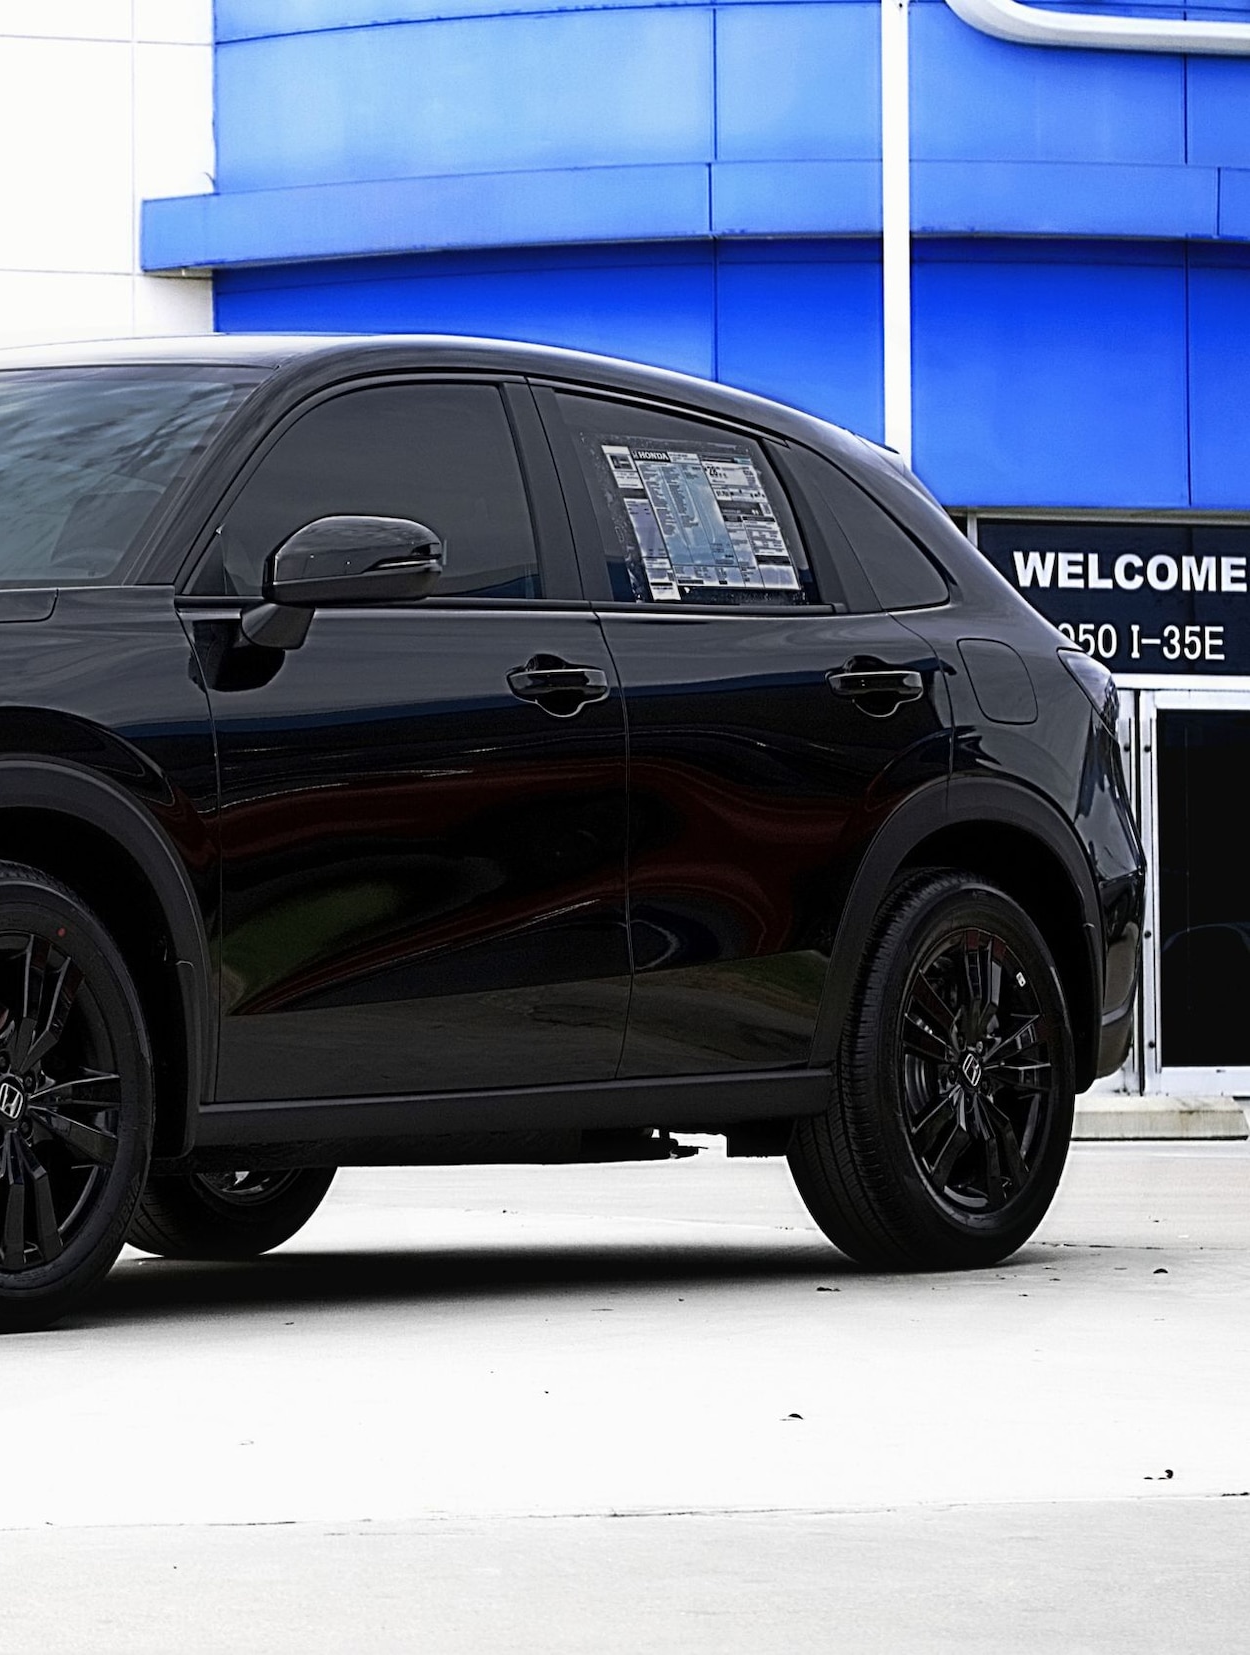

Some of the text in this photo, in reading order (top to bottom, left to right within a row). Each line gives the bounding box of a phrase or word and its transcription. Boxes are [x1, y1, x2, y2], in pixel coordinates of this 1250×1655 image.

[638, 451, 669, 460] HONDA
[1013, 551, 1247, 592] WELCOME
[1131, 624, 1225, 661] I-35E
